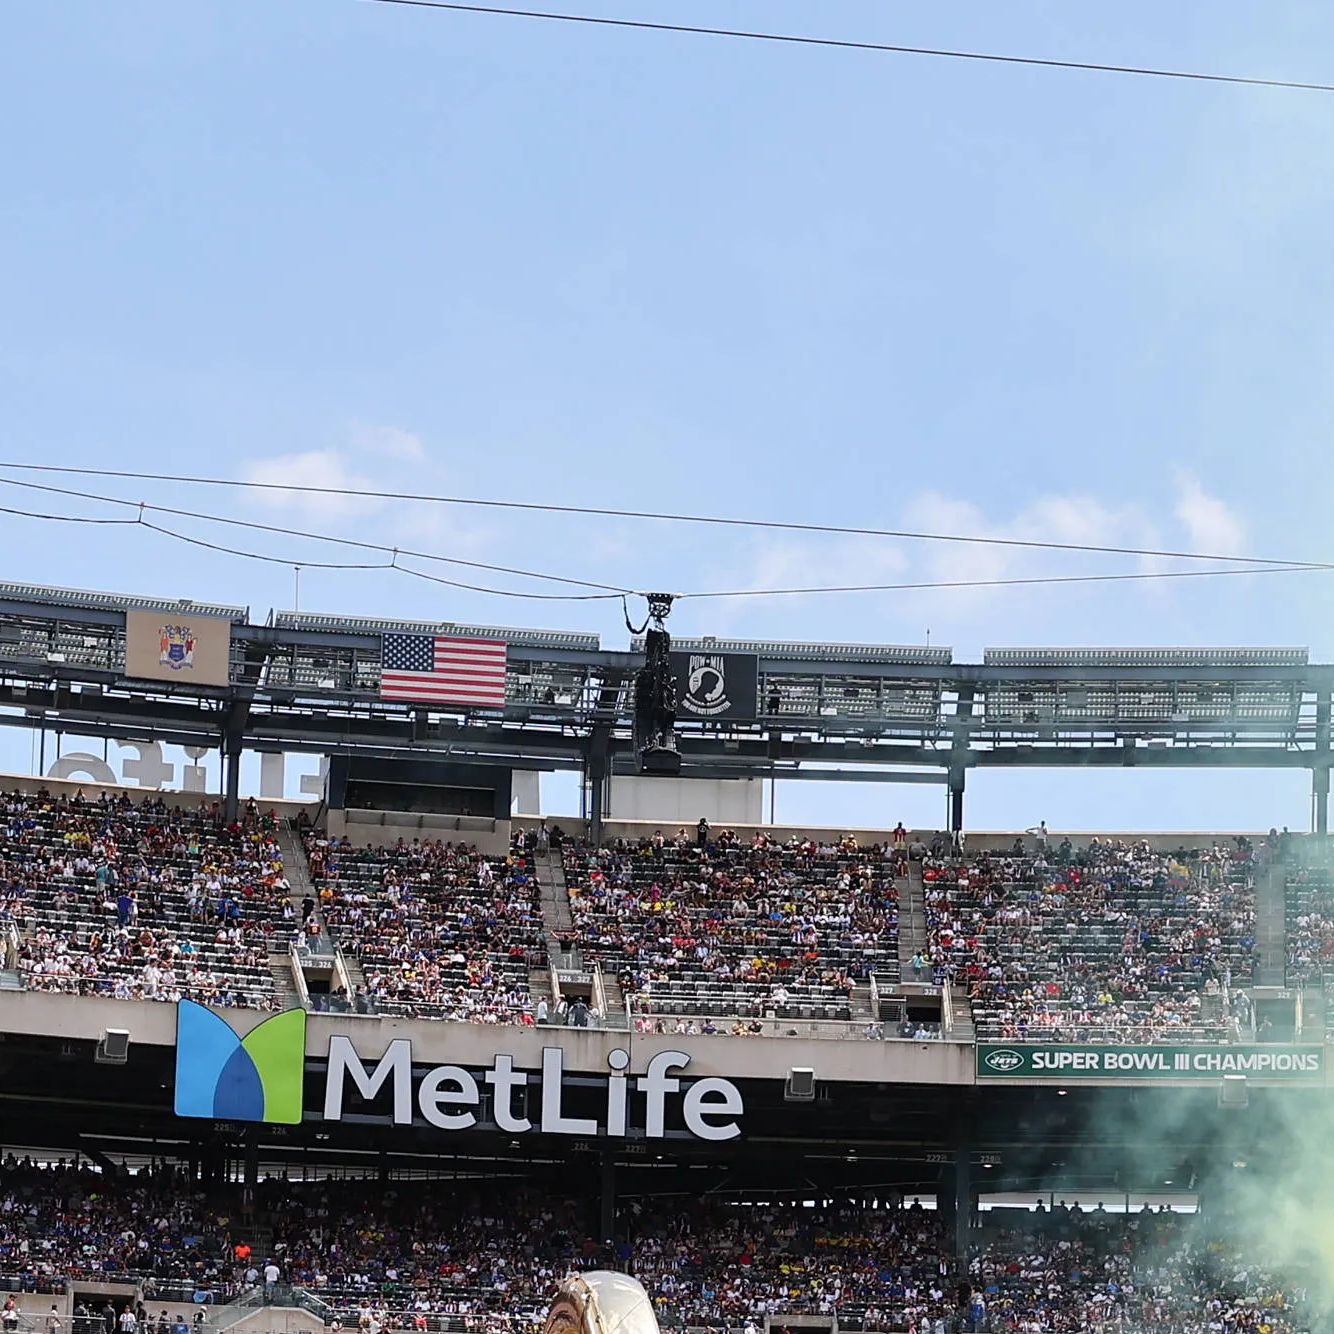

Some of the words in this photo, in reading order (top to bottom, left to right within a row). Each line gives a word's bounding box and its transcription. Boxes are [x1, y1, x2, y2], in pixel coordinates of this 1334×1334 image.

[323, 1034, 745, 1142] MetLife
[1031, 1051, 1100, 1071] SUPER
[1103, 1052, 1171, 1071] BOWL
[1174, 1052, 1190, 1071] III
[1192, 1052, 1320, 1072] CHAMPIONS
